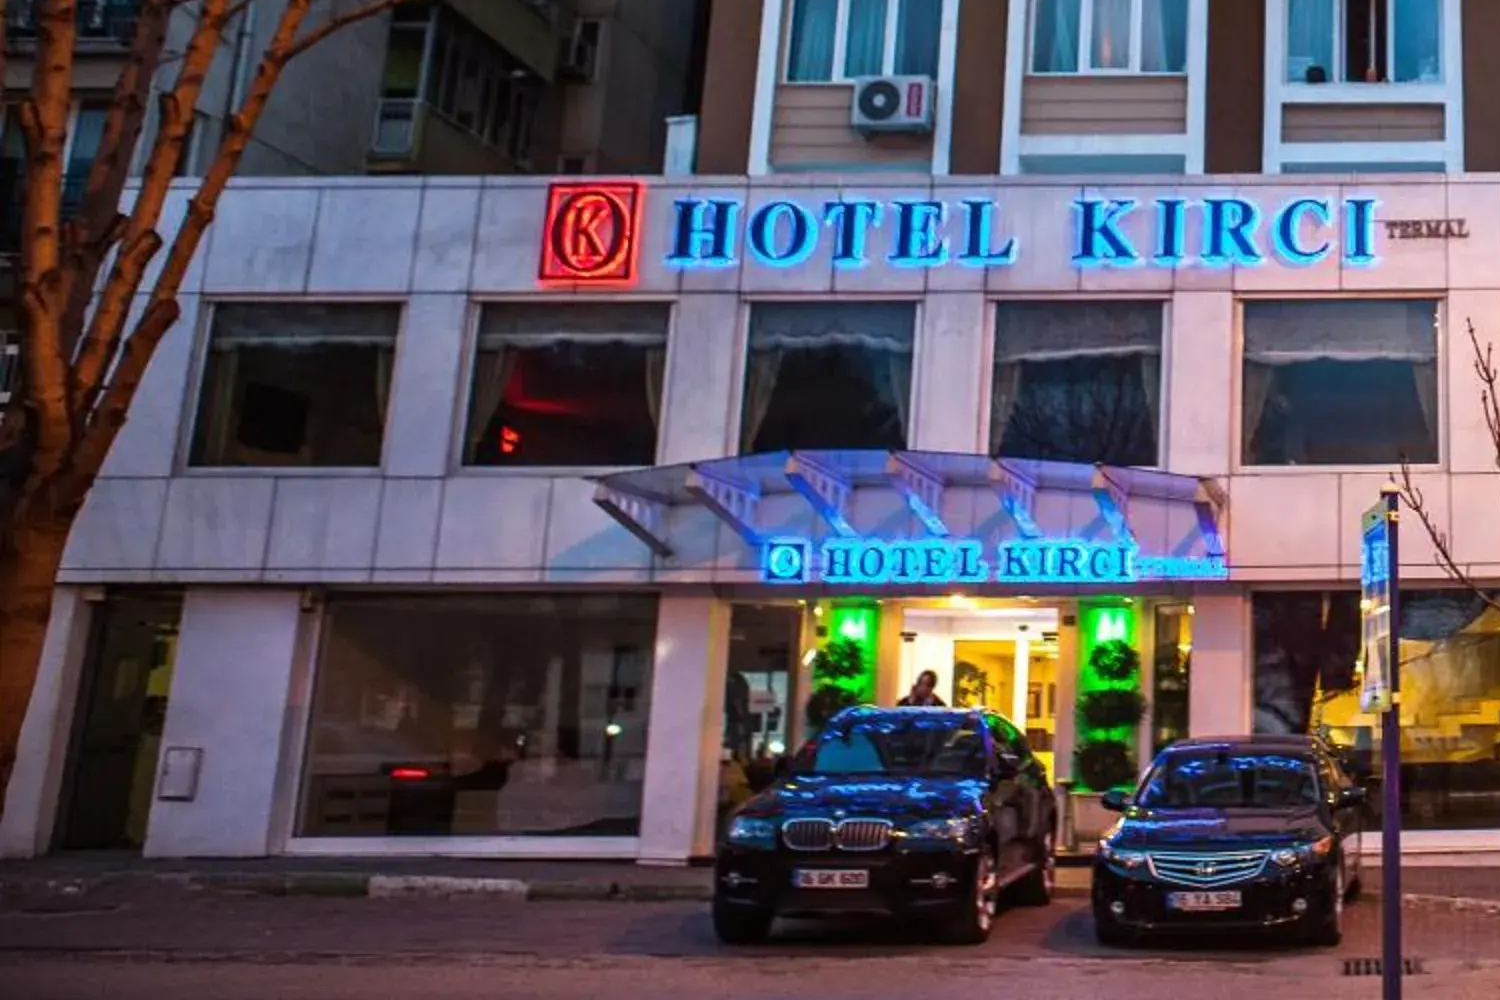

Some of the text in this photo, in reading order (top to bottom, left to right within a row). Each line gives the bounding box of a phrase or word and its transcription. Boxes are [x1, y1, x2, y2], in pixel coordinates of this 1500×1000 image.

[666, 197, 1379, 263] HOTEL KIRCI
[1385, 218, 1470, 239] TERMAL
[826, 546, 982, 578] HOTEL
[1003, 546, 1131, 578] KIRCI
